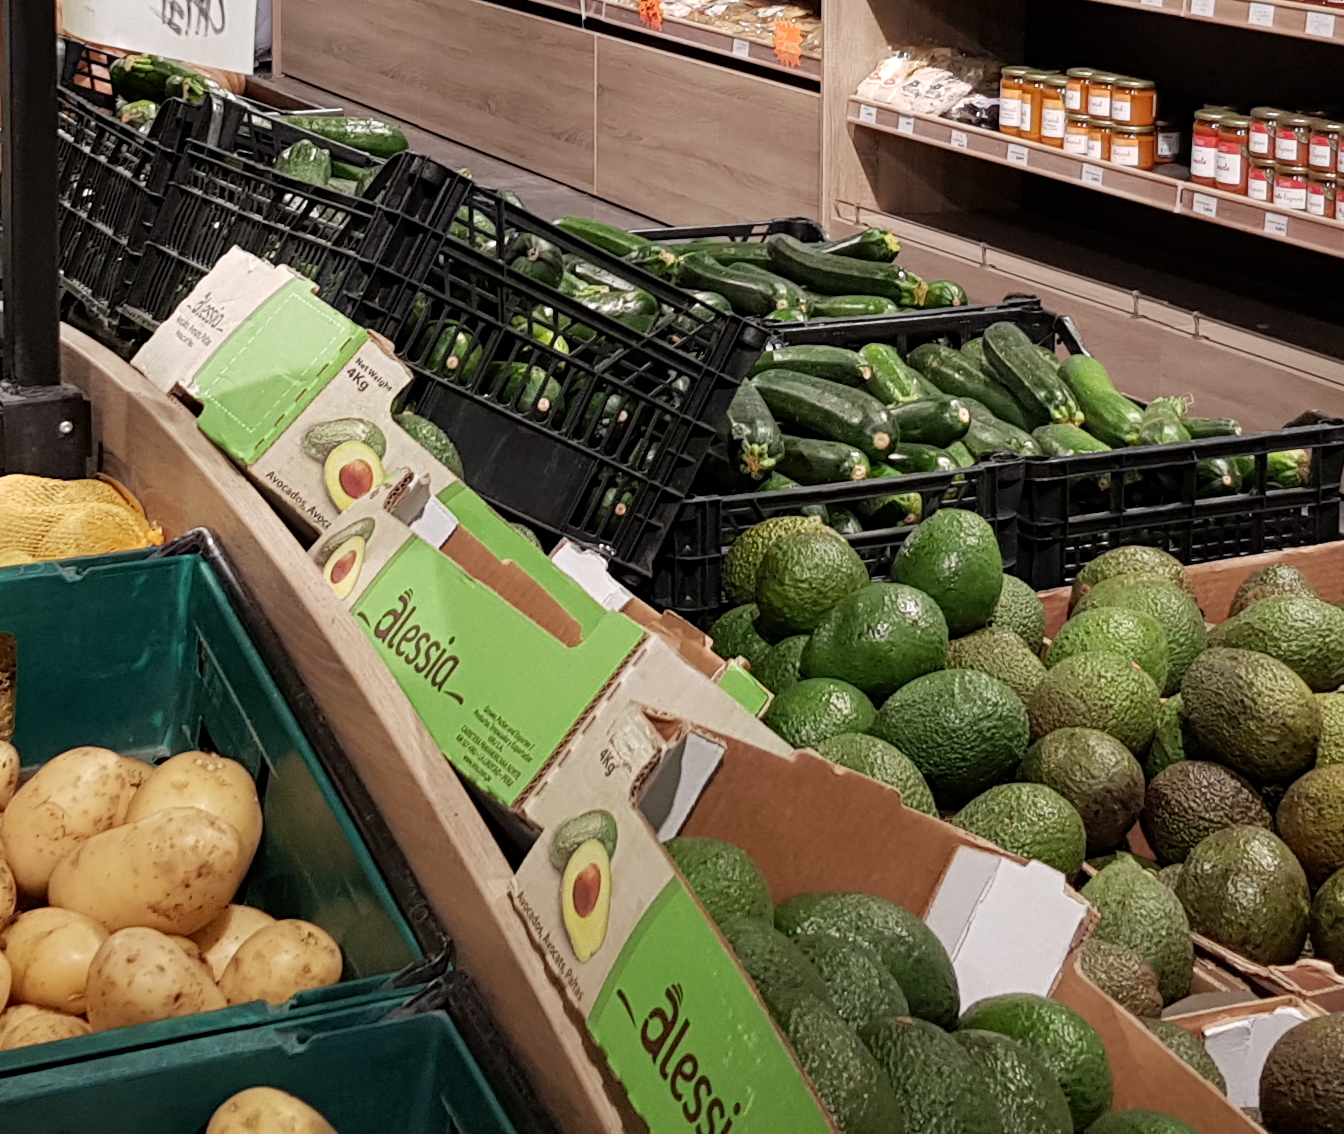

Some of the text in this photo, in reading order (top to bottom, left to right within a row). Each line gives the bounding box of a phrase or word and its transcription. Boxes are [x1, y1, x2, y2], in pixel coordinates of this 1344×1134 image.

[346, 367, 370, 393] 4Kg
[355, 357, 393, 392] Net Weight
[265, 470, 306, 511] Avocados,
[373, 588, 460, 693] alessia
[516, 891, 543, 940] Avocados,
[542, 931, 566, 975] Avocats,
